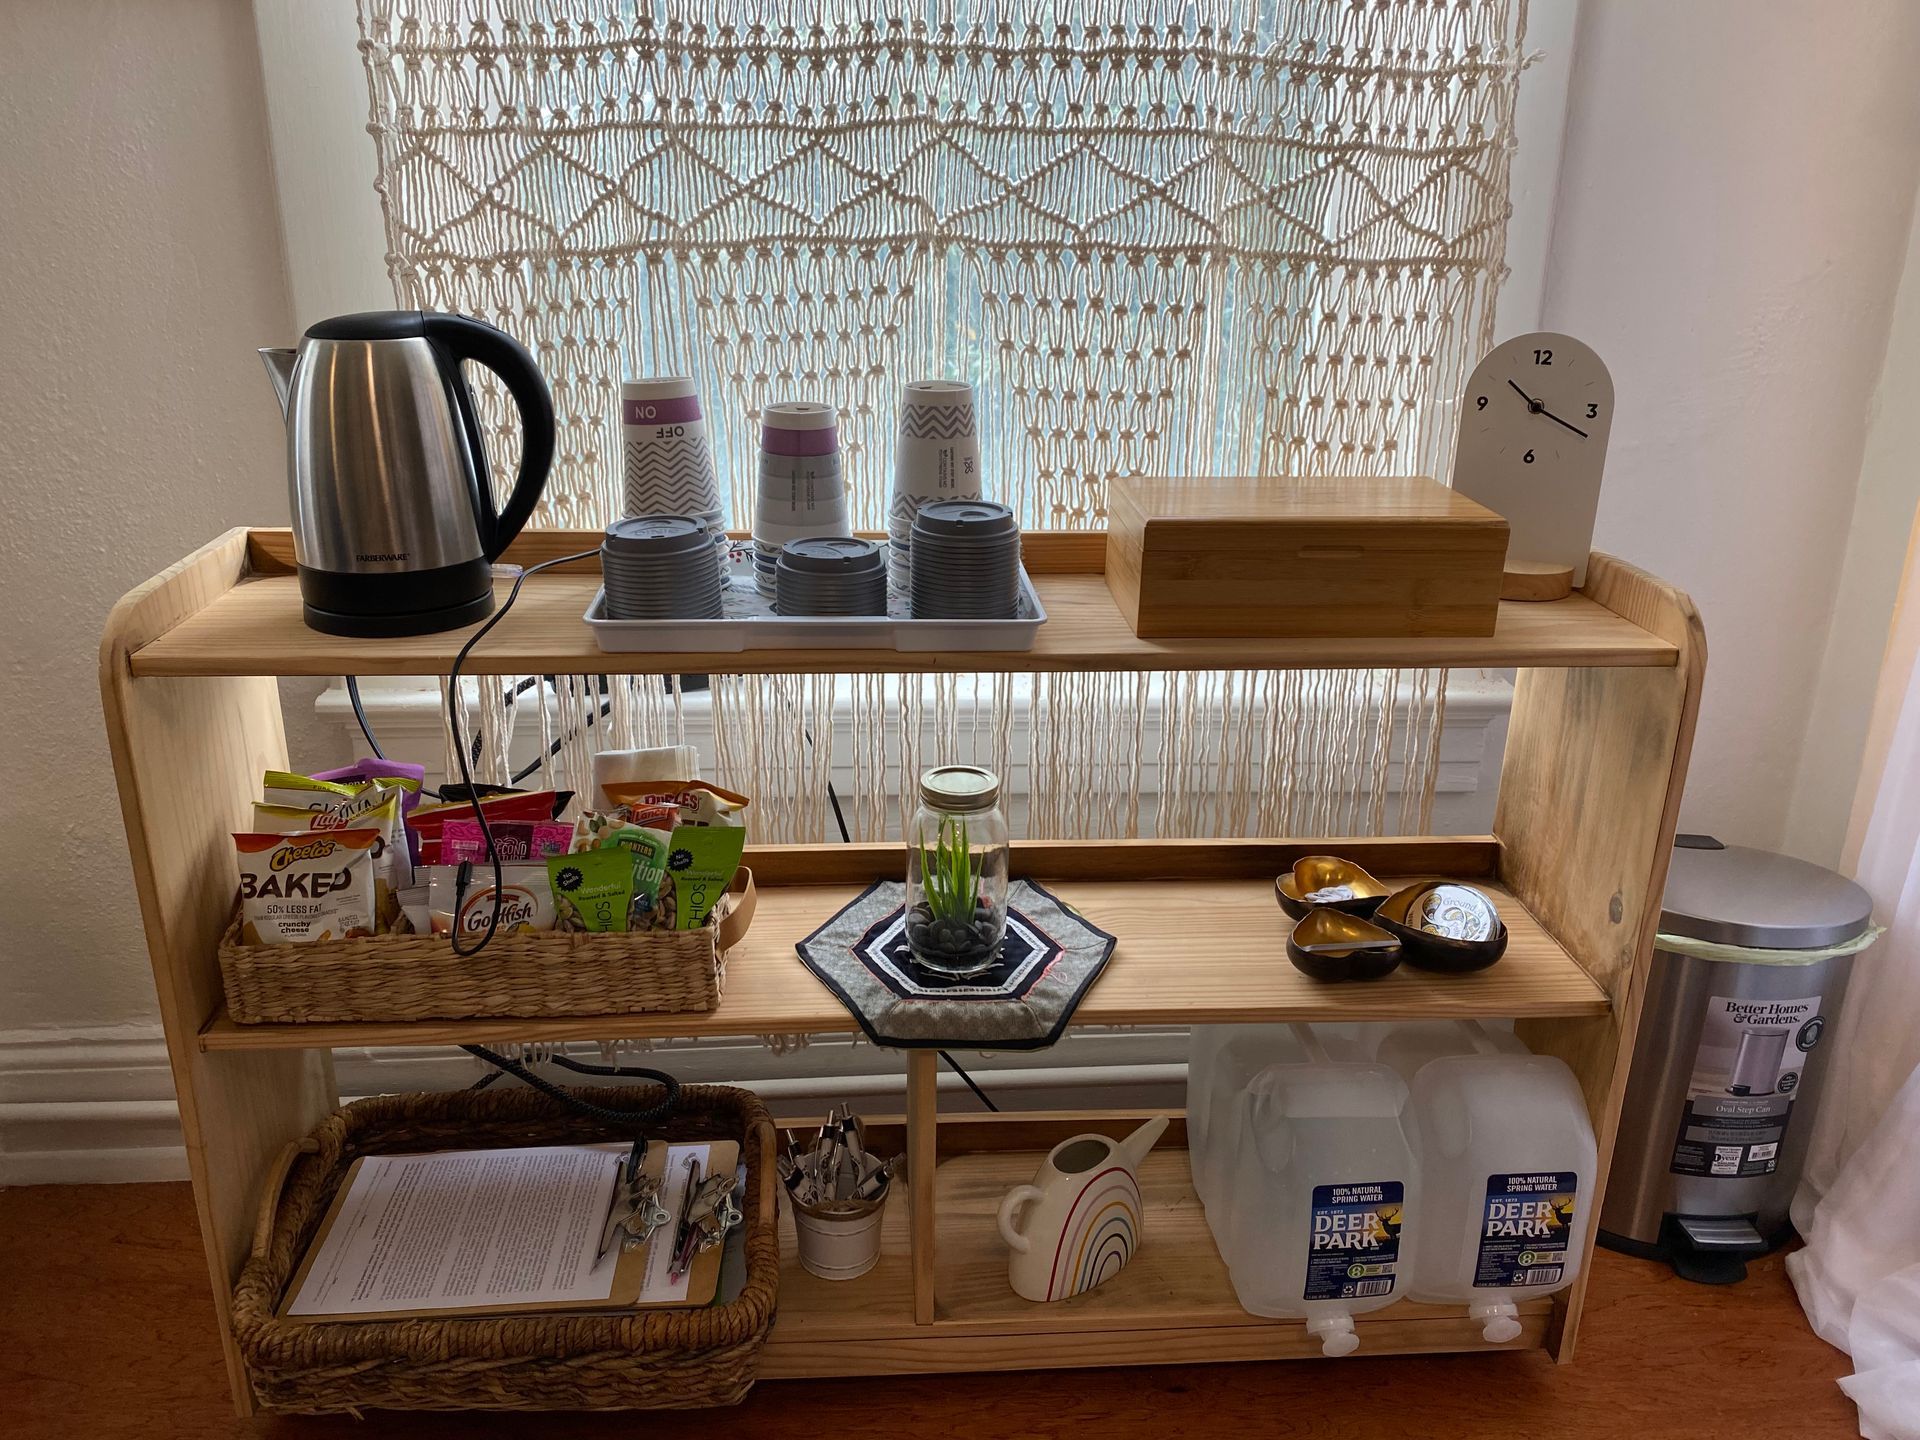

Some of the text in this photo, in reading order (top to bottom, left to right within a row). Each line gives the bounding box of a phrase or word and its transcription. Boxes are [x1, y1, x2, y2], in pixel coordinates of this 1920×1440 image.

[1533, 349, 1553, 366] 12
[1476, 396, 1489, 411] 9
[1586, 403, 1598, 419] 3
[656, 426, 685, 439] OFF
[1523, 449, 1535, 464] 6
[356, 553, 407, 562] FARBERWARE
[270, 841, 335, 871] Cheetos
[240, 867, 352, 898] BAKED
[562, 876, 578, 886] Shells
[267, 904, 322, 914] 50% LESS FAT
[467, 902, 531, 931] Godfish
[1726, 1002, 1808, 1014] Better Homes
[1737, 1106, 1754, 1114] Step
[1352, 1186, 1382, 1195] NATURAL
[1332, 1196, 1358, 1204] SPRING
[1488, 1202, 1552, 1220] DEER
[1314, 1212, 1380, 1233] DEER
[1486, 1219, 1550, 1237] PARK
[1313, 1231, 1379, 1250] PARK
